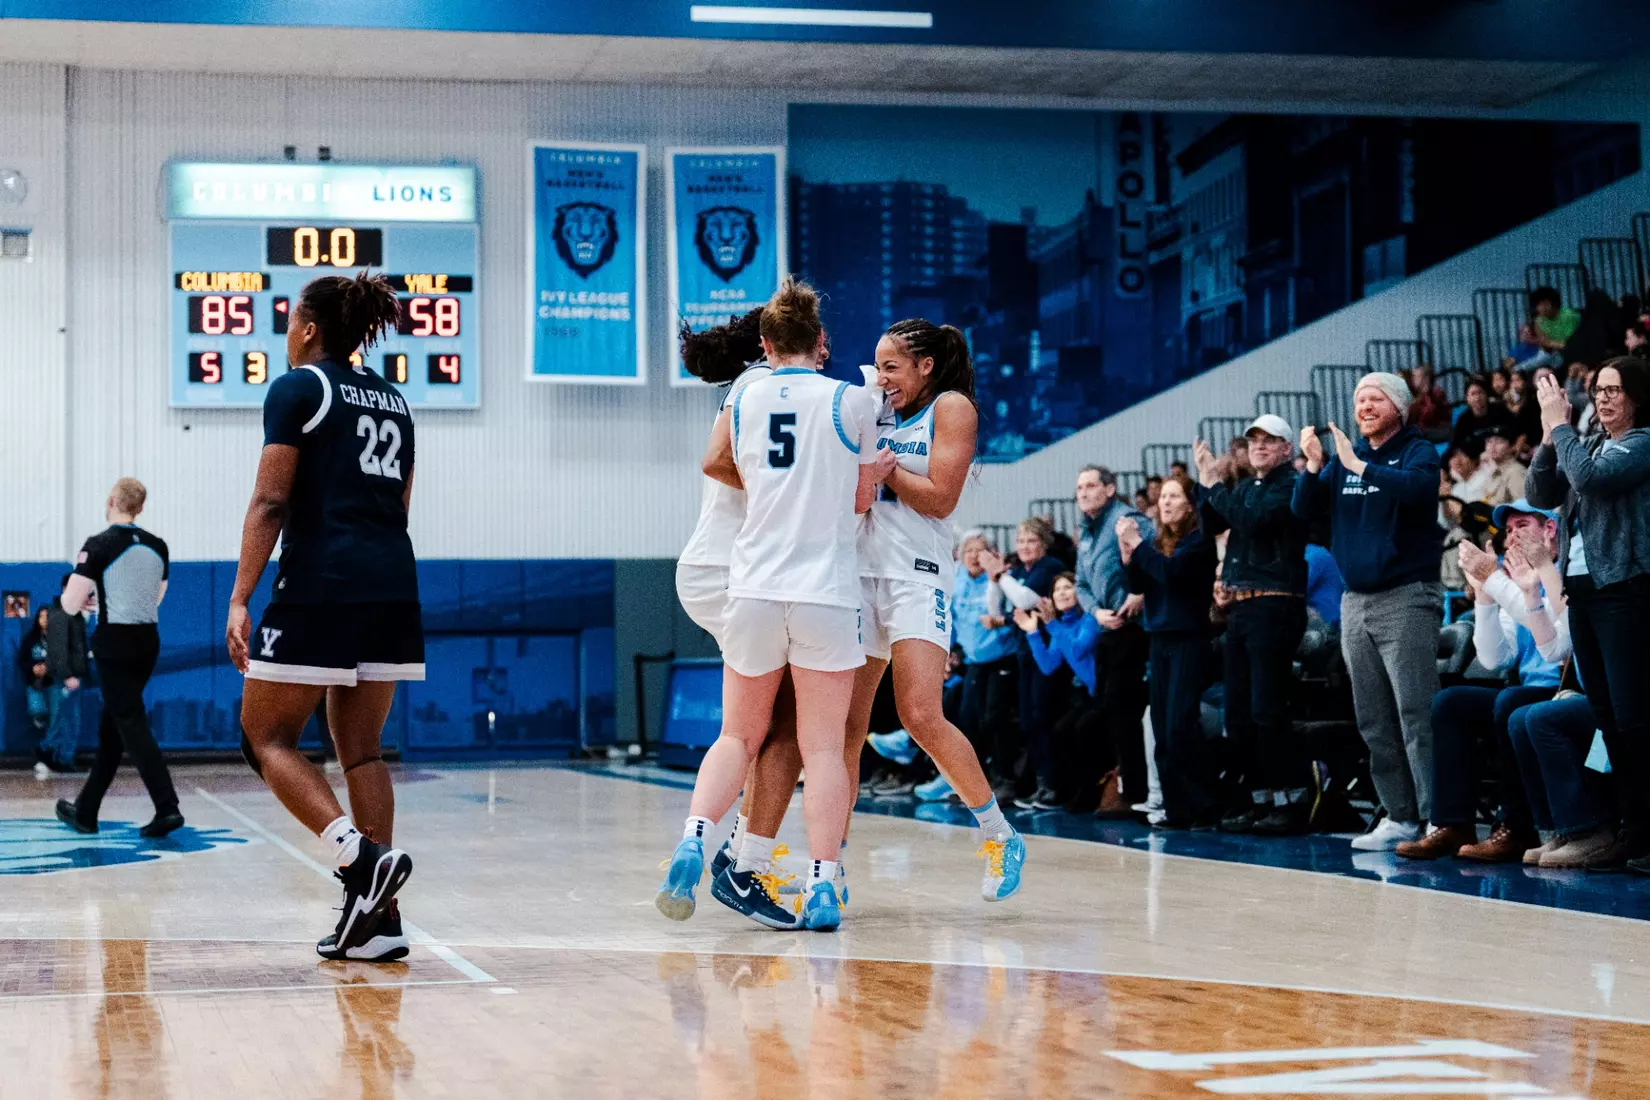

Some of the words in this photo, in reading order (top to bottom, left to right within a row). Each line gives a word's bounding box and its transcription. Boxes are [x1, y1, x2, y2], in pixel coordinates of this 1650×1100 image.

[193, 181, 331, 202] COLUMBI
[373, 185, 453, 202] LIONS
[1118, 111, 1144, 293] APOLLO
[294, 227, 355, 267] 0.0
[181, 271, 263, 292] COLUMBIA
[404, 273, 449, 294] YALE
[541, 289, 566, 303] IVY
[568, 291, 628, 306] LEAGUE
[202, 295, 252, 335] 85
[409, 297, 460, 337] 58
[539, 305, 630, 321] CHAMPIONS
[200, 352, 221, 384] 5
[247, 352, 266, 384] 3
[396, 355, 407, 384] 1
[439, 355, 459, 384] 4
[340, 383, 407, 416] CHAPMAN
[779, 387, 788, 398] C
[356, 414, 403, 480] 22
[767, 411, 797, 469] 5
[260, 626, 283, 658] Y
